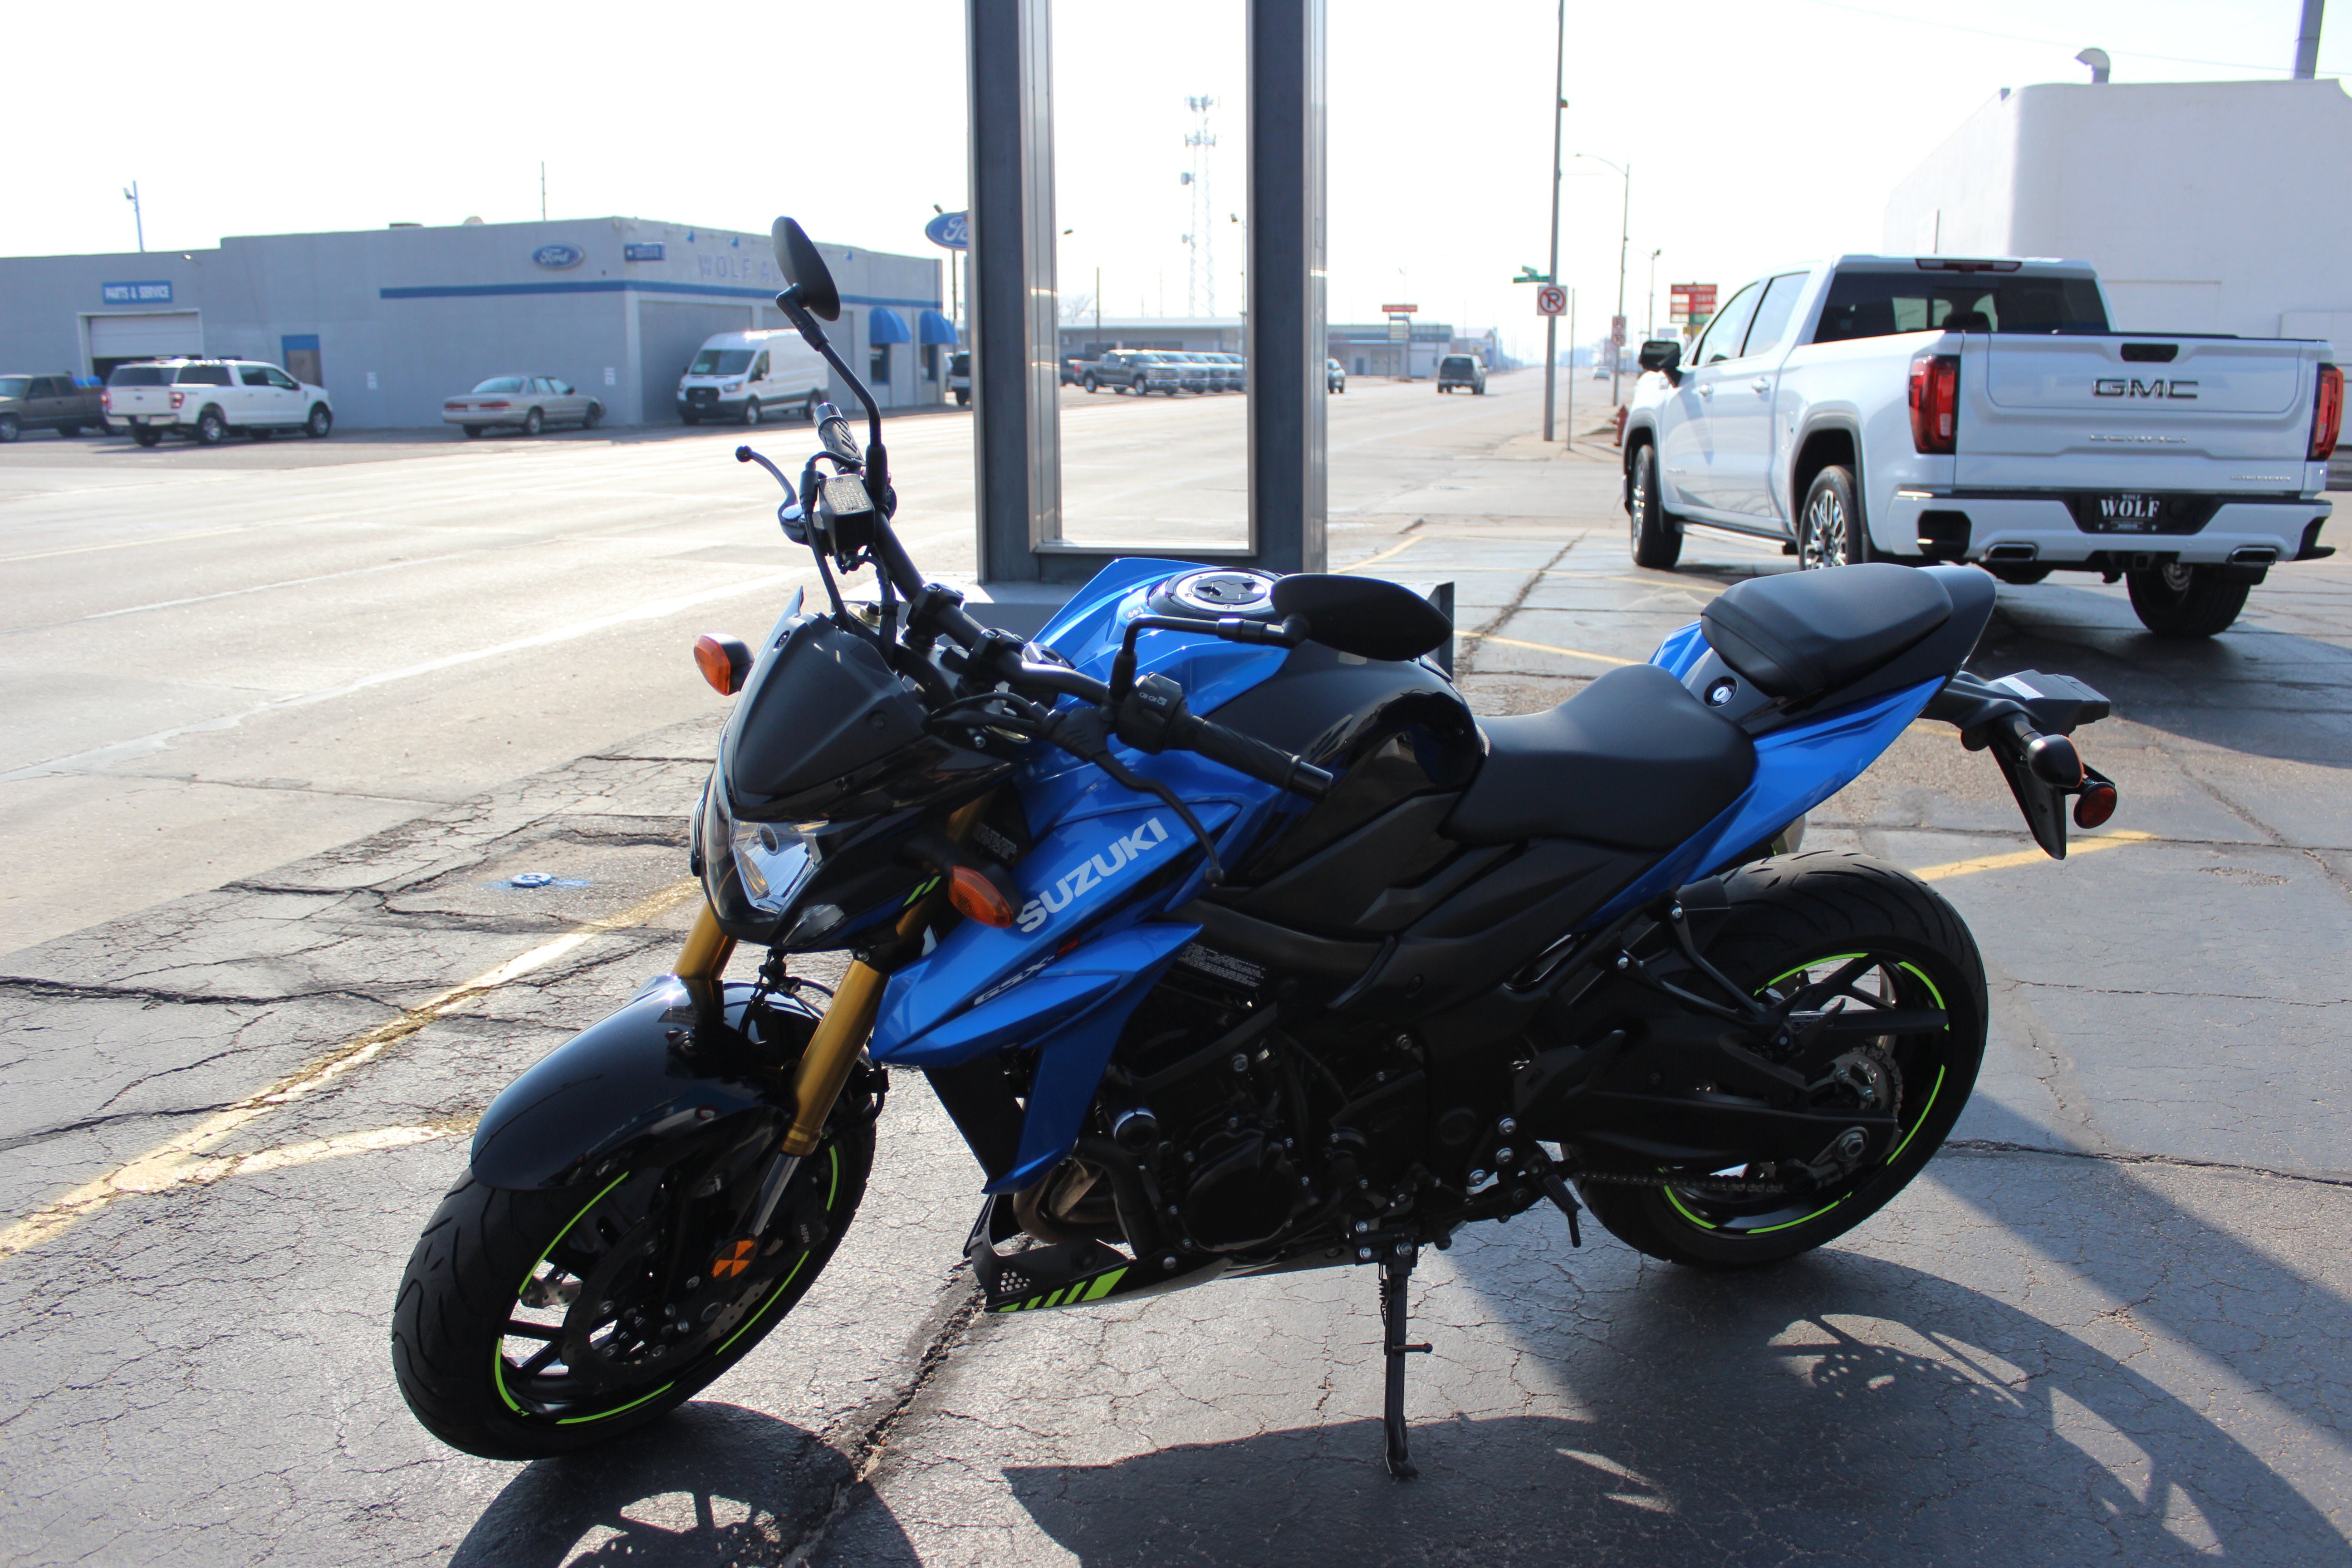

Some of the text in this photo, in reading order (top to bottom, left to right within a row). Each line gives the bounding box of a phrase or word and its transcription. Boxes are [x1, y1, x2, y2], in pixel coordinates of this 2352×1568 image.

[943, 216, 969, 242] Fo
[539, 248, 570, 263] Ford
[697, 253, 781, 282] WOLF AU
[105, 287, 128, 299] PARTS
[138, 285, 169, 299] SERVICE
[2092, 378, 2199, 399] GMC
[2100, 499, 2160, 517] WOLF
[1016, 817, 1168, 932] SUZUKI
